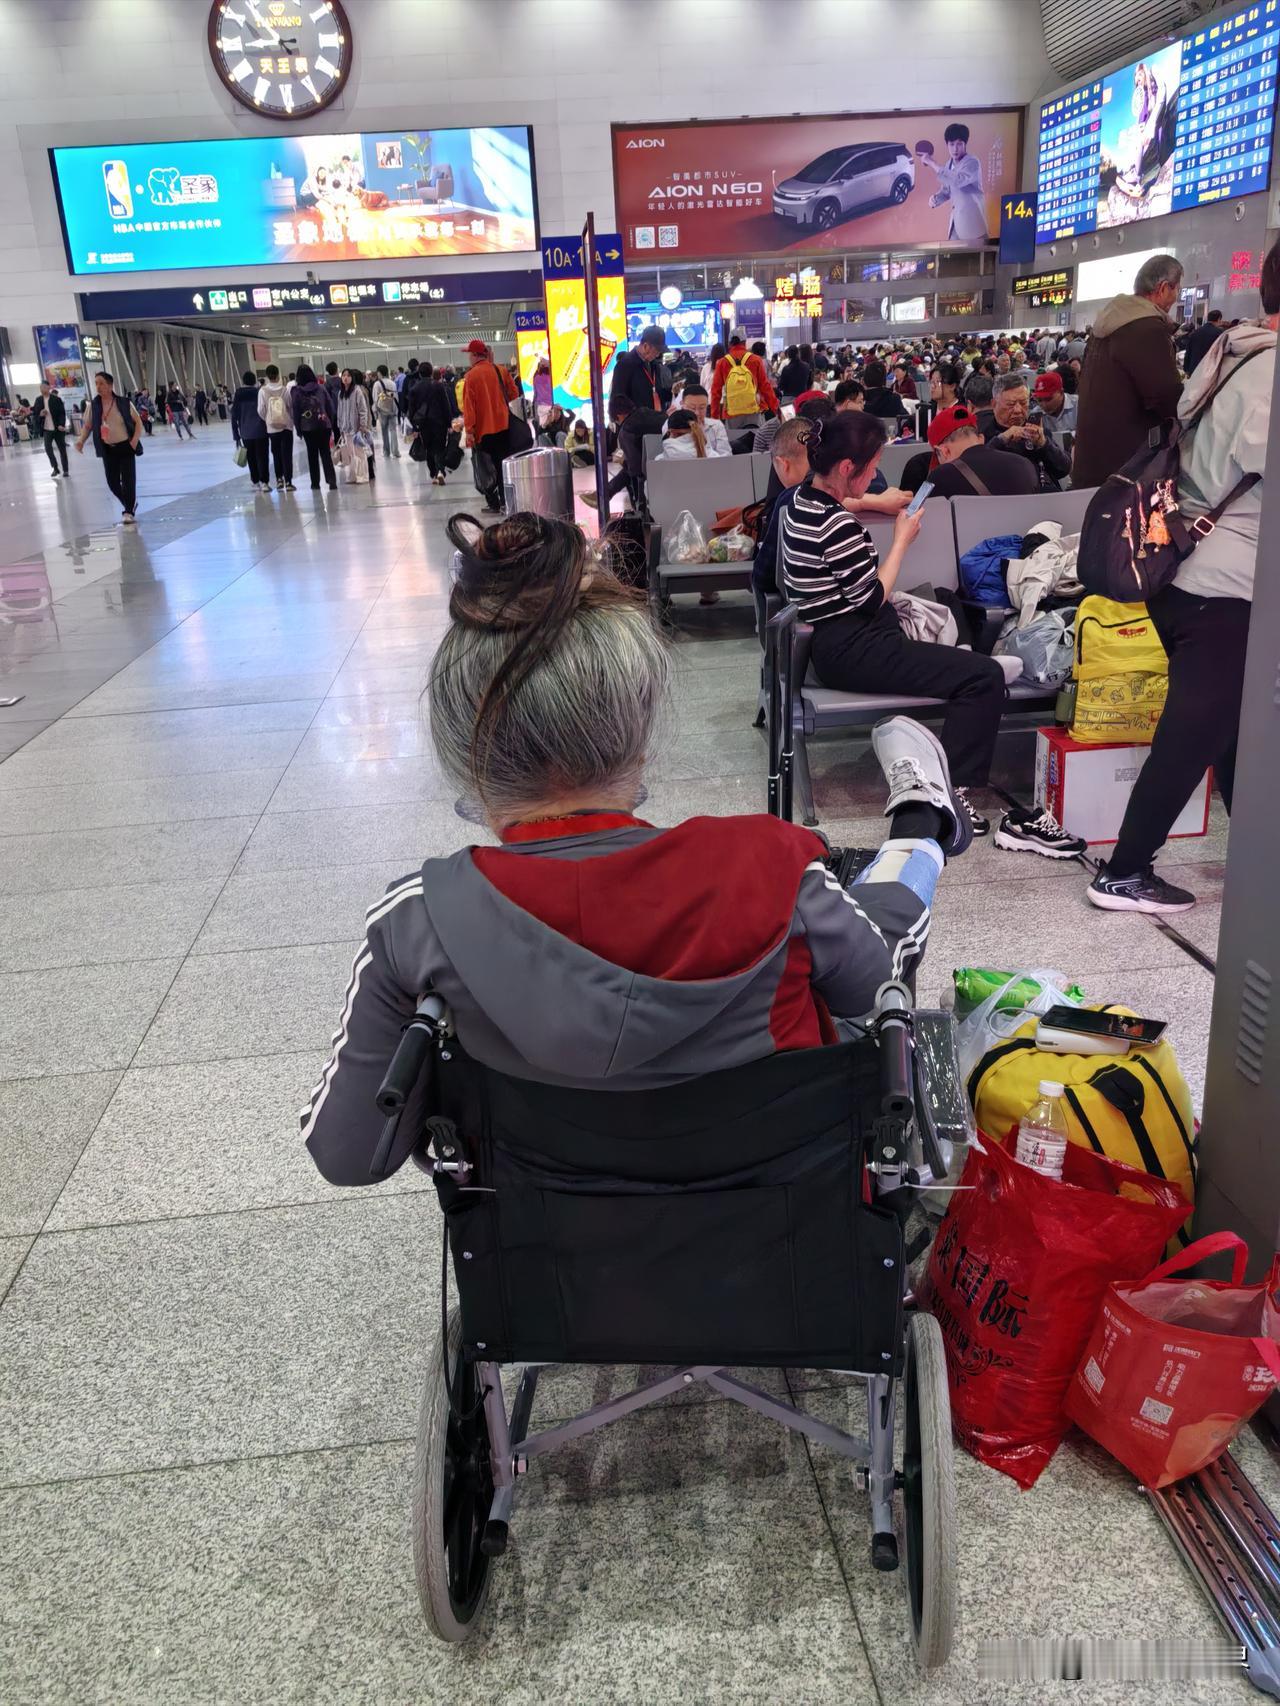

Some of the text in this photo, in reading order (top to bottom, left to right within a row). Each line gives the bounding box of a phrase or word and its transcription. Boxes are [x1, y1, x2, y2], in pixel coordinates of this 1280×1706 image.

[626, 138, 665, 149] AION
[647, 182, 762, 199] AION N60
[1005, 200, 1033, 220] 14A
[348, 284, 376, 298] 出租车
[401, 281, 429, 294] 停车场
[775, 275, 821, 297] 烤肠
[228, 290, 247, 303] 出口
